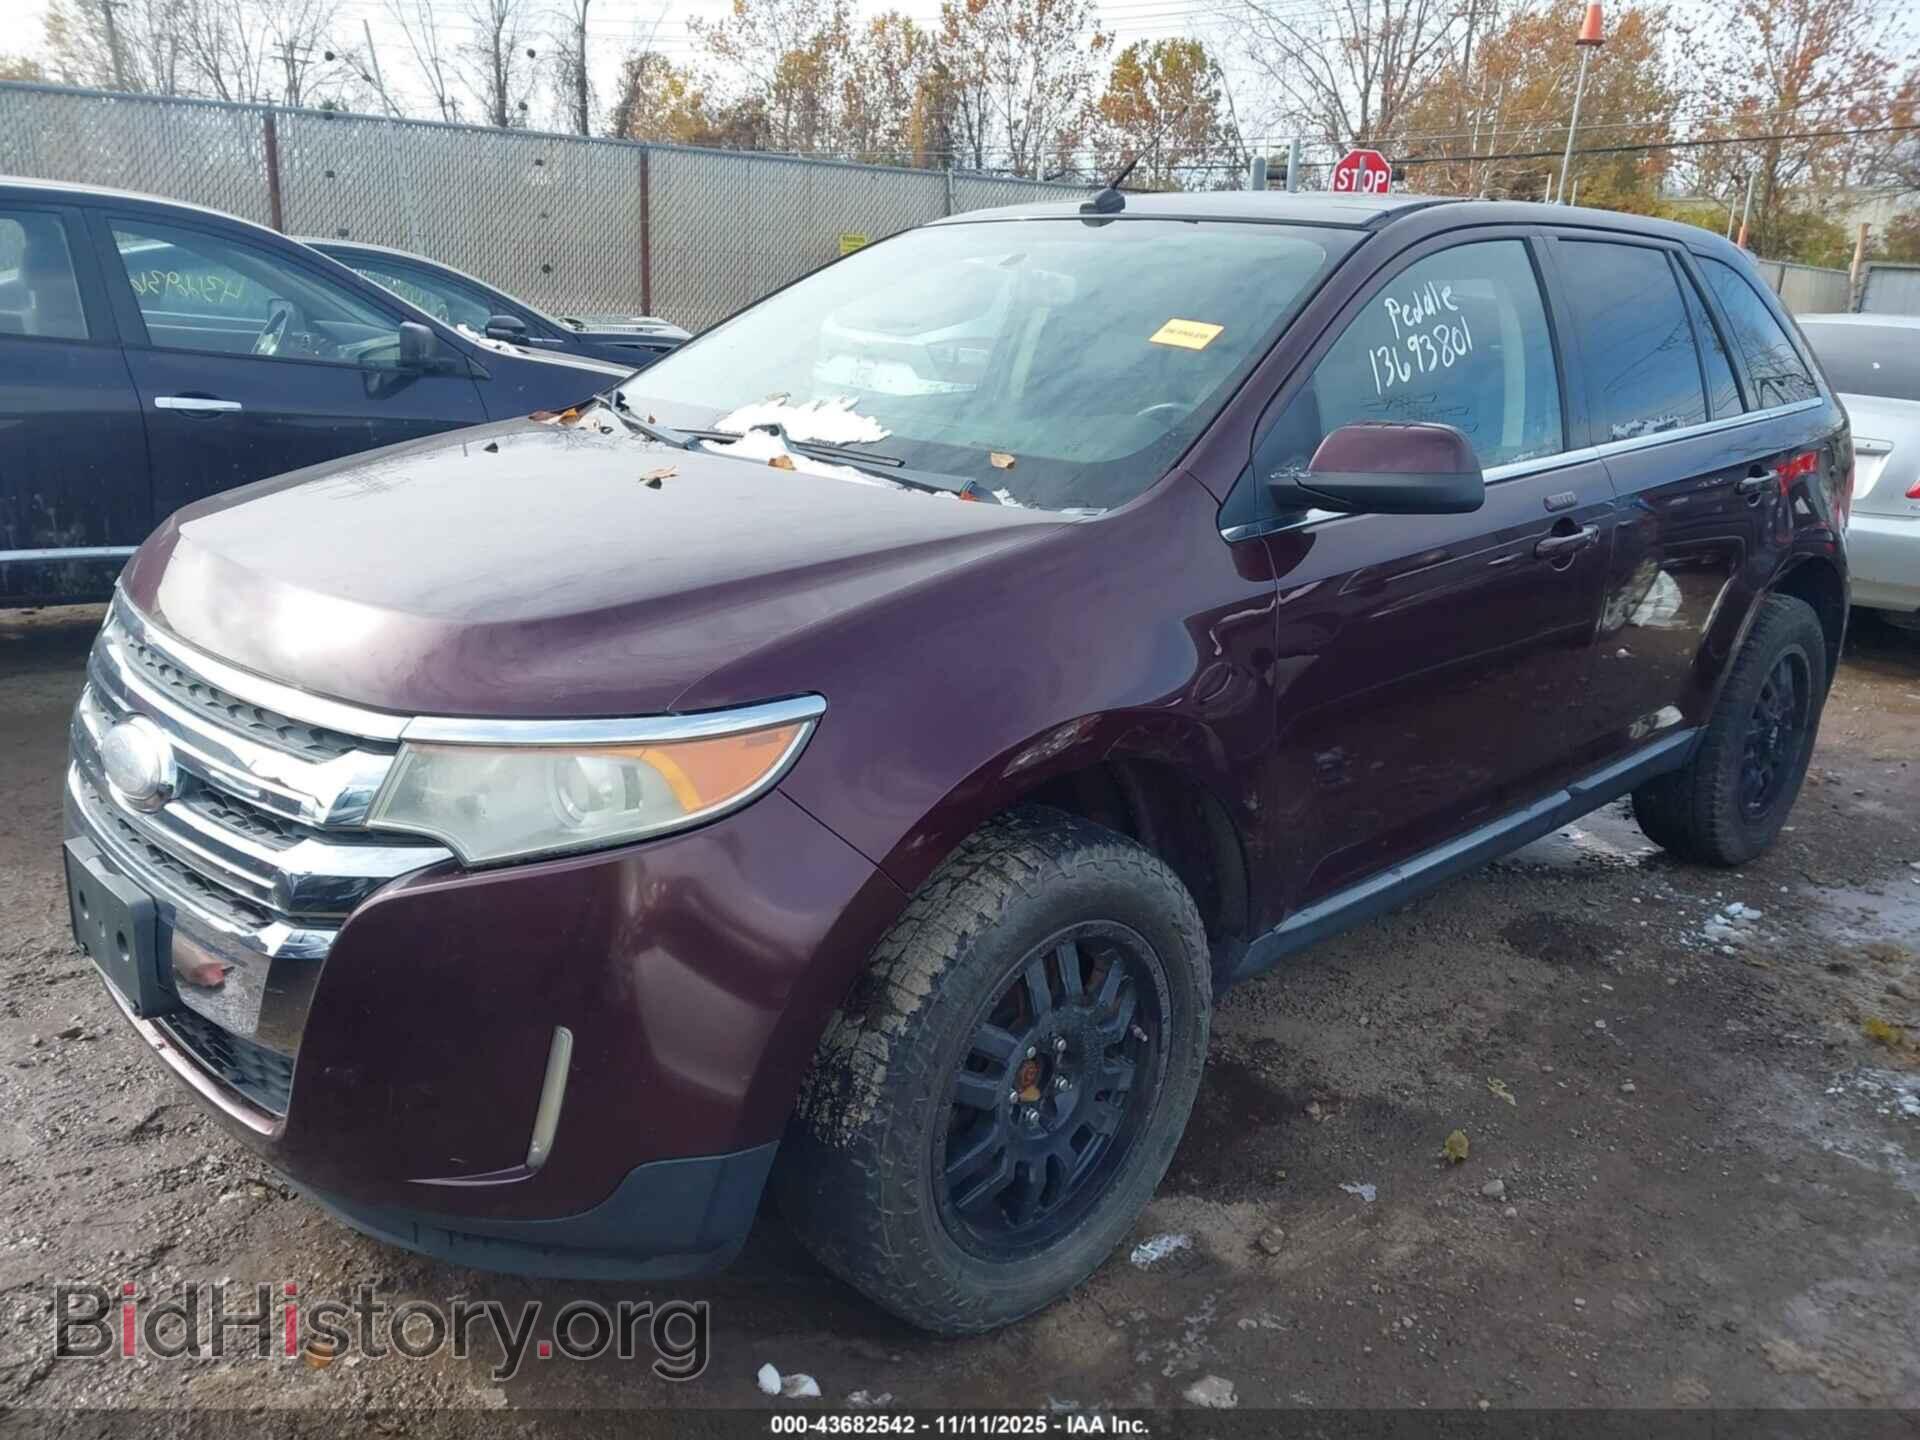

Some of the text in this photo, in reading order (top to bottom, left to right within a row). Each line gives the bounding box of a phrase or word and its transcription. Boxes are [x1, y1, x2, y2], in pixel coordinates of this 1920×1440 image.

[1337, 168, 1387, 192] STOP
[1384, 281, 1459, 340] Peddle
[1369, 316, 1472, 395] 13693801
